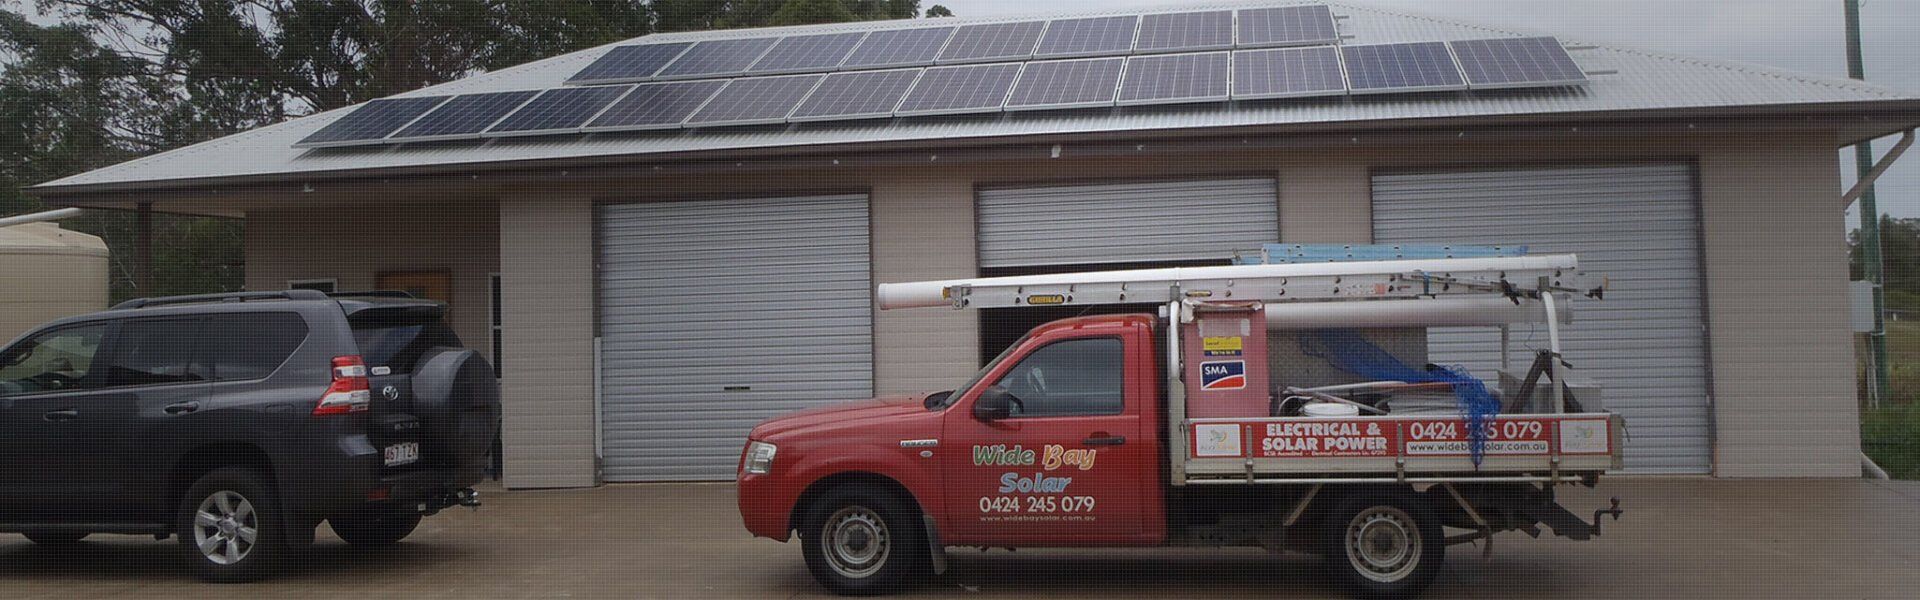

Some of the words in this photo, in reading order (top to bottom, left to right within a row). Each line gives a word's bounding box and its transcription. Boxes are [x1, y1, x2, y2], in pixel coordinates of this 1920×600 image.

[1204, 365, 1228, 375] SMA
[1266, 423, 1360, 436] ELECTRICAL
[1366, 422, 1382, 436] &
[1410, 421, 1457, 440] 0424
[1503, 420, 1543, 439] 079
[1262, 437, 1320, 451] SOLAR
[1324, 437, 1388, 451] POWER
[973, 444, 1035, 466] Wide
[1042, 444, 1097, 470] Bay
[999, 472, 1073, 493] Solar
[979, 496, 1020, 512] 0424
[1027, 496, 1056, 512] 245
[1061, 496, 1096, 512] 079
